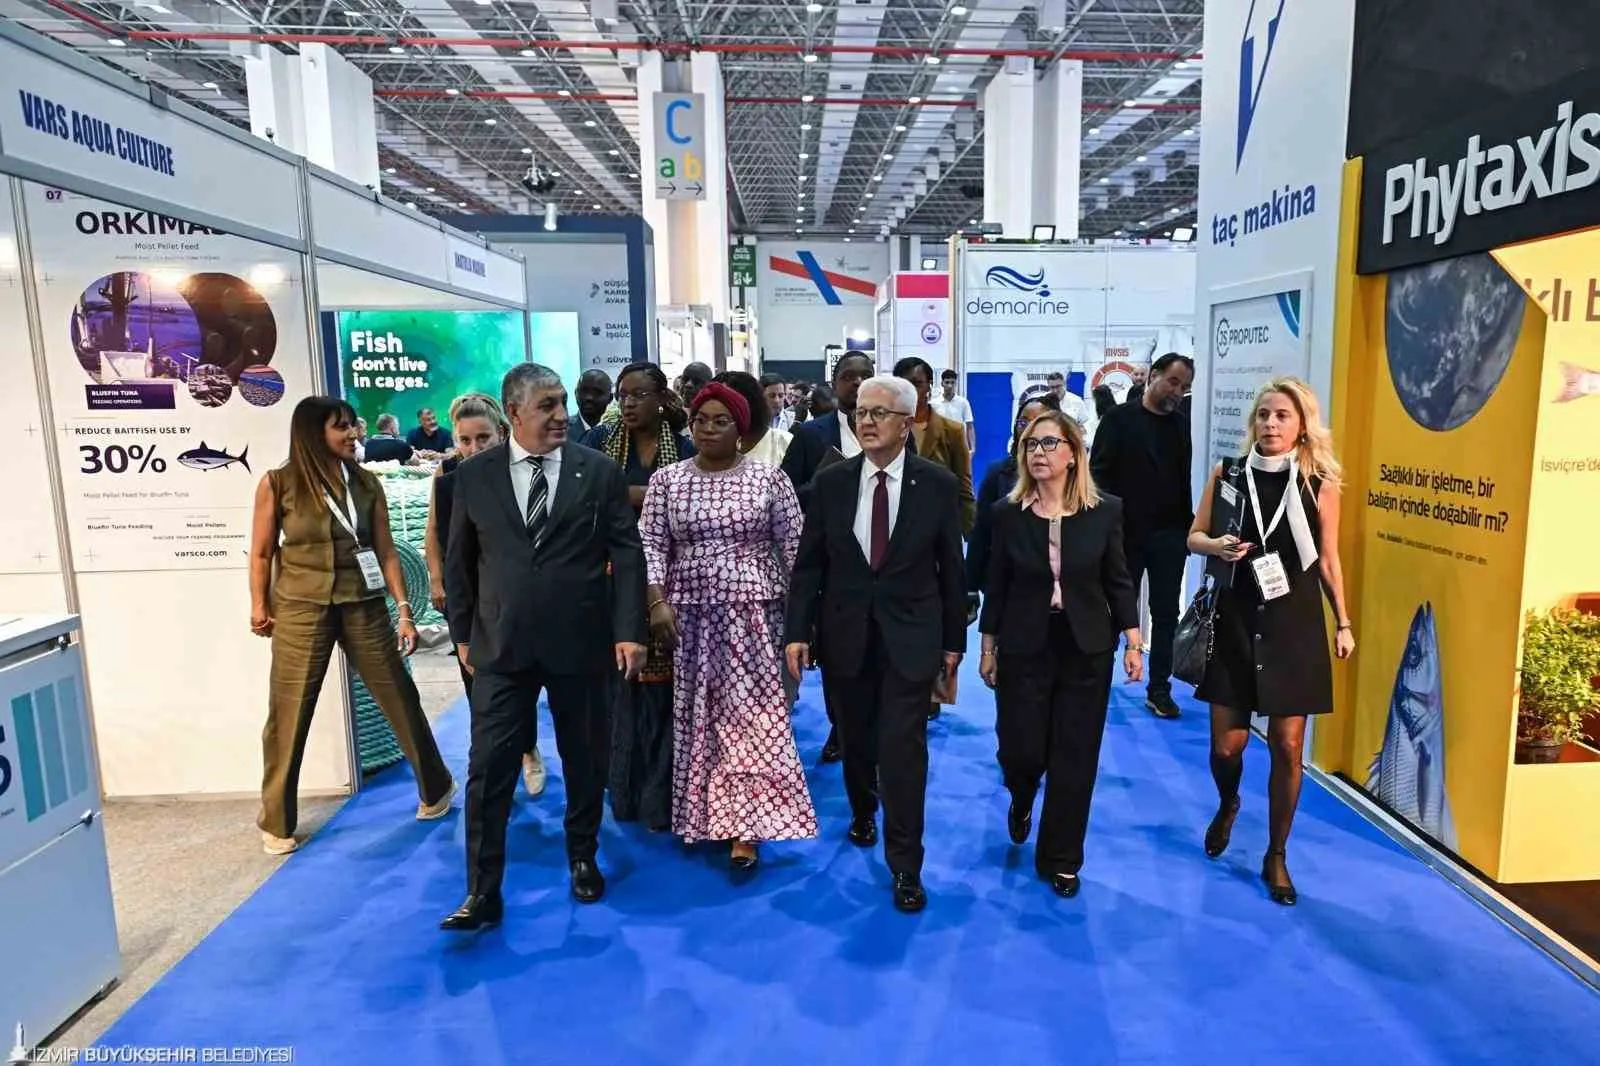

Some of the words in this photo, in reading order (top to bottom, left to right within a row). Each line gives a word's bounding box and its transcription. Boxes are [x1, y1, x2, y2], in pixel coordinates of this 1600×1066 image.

[19, 89, 69, 141] VARS
[71, 110, 116, 156] AQUA
[117, 128, 175, 177] CULTURE
[666, 100, 692, 144] C
[660, 158, 676, 178] a
[684, 152, 702, 180] b
[1382, 101, 1600, 246] Phytaxis
[46, 190, 62, 200] 07
[76, 210, 227, 236] ORKIMA
[1212, 214, 1238, 247] taç
[1243, 184, 1316, 236] makina
[158, 242, 180, 250] Pellet
[604, 279, 629, 288] DÜŞÜ
[966, 297, 1069, 314] demarine
[350, 330, 403, 354] Fish
[606, 330, 630, 339] İŞGÜC
[1228, 326, 1269, 345] PROPUTEC
[352, 356, 397, 372] don't
[400, 356, 428, 372] live
[354, 372, 370, 388] in
[374, 375, 429, 392] cages.
[80, 444, 167, 474] 30%
[1380, 463, 1413, 487] Sağlıklı
[1414, 472, 1430, 487] bir
[1431, 474, 1475, 498] işletme,
[1478, 476, 1496, 498] bir
[1368, 489, 1398, 513] balığın
[1400, 494, 1430, 518] içinde
[1432, 500, 1482, 528] doğabilir
[1484, 511, 1509, 532] mi?
